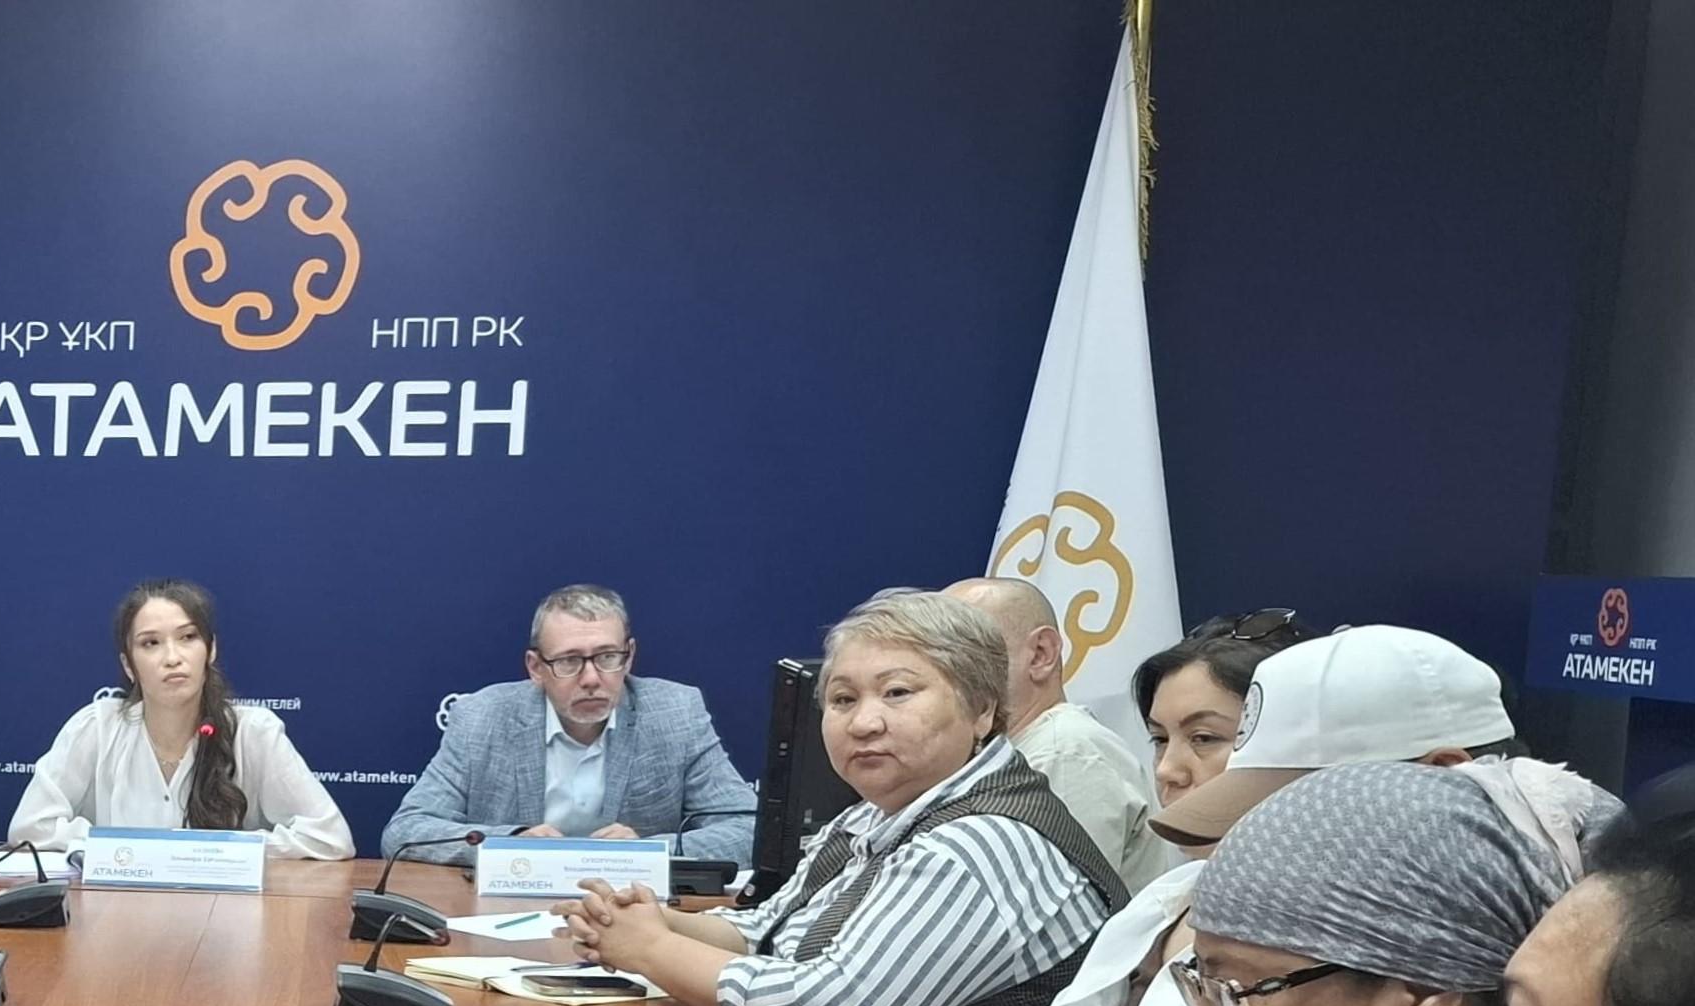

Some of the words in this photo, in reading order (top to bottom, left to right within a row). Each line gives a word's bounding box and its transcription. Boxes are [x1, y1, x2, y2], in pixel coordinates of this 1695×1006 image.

[0, 321, 49, 358] ҚР
[58, 320, 135, 351] ҰКП
[371, 316, 459, 349] НПП
[471, 316, 524, 347] РК
[1562, 653, 1655, 686] АТАМЕКЕН
[92, 866, 154, 879] АТАМЕКЕН
[488, 879, 554, 890] АТАМЕКЕН
